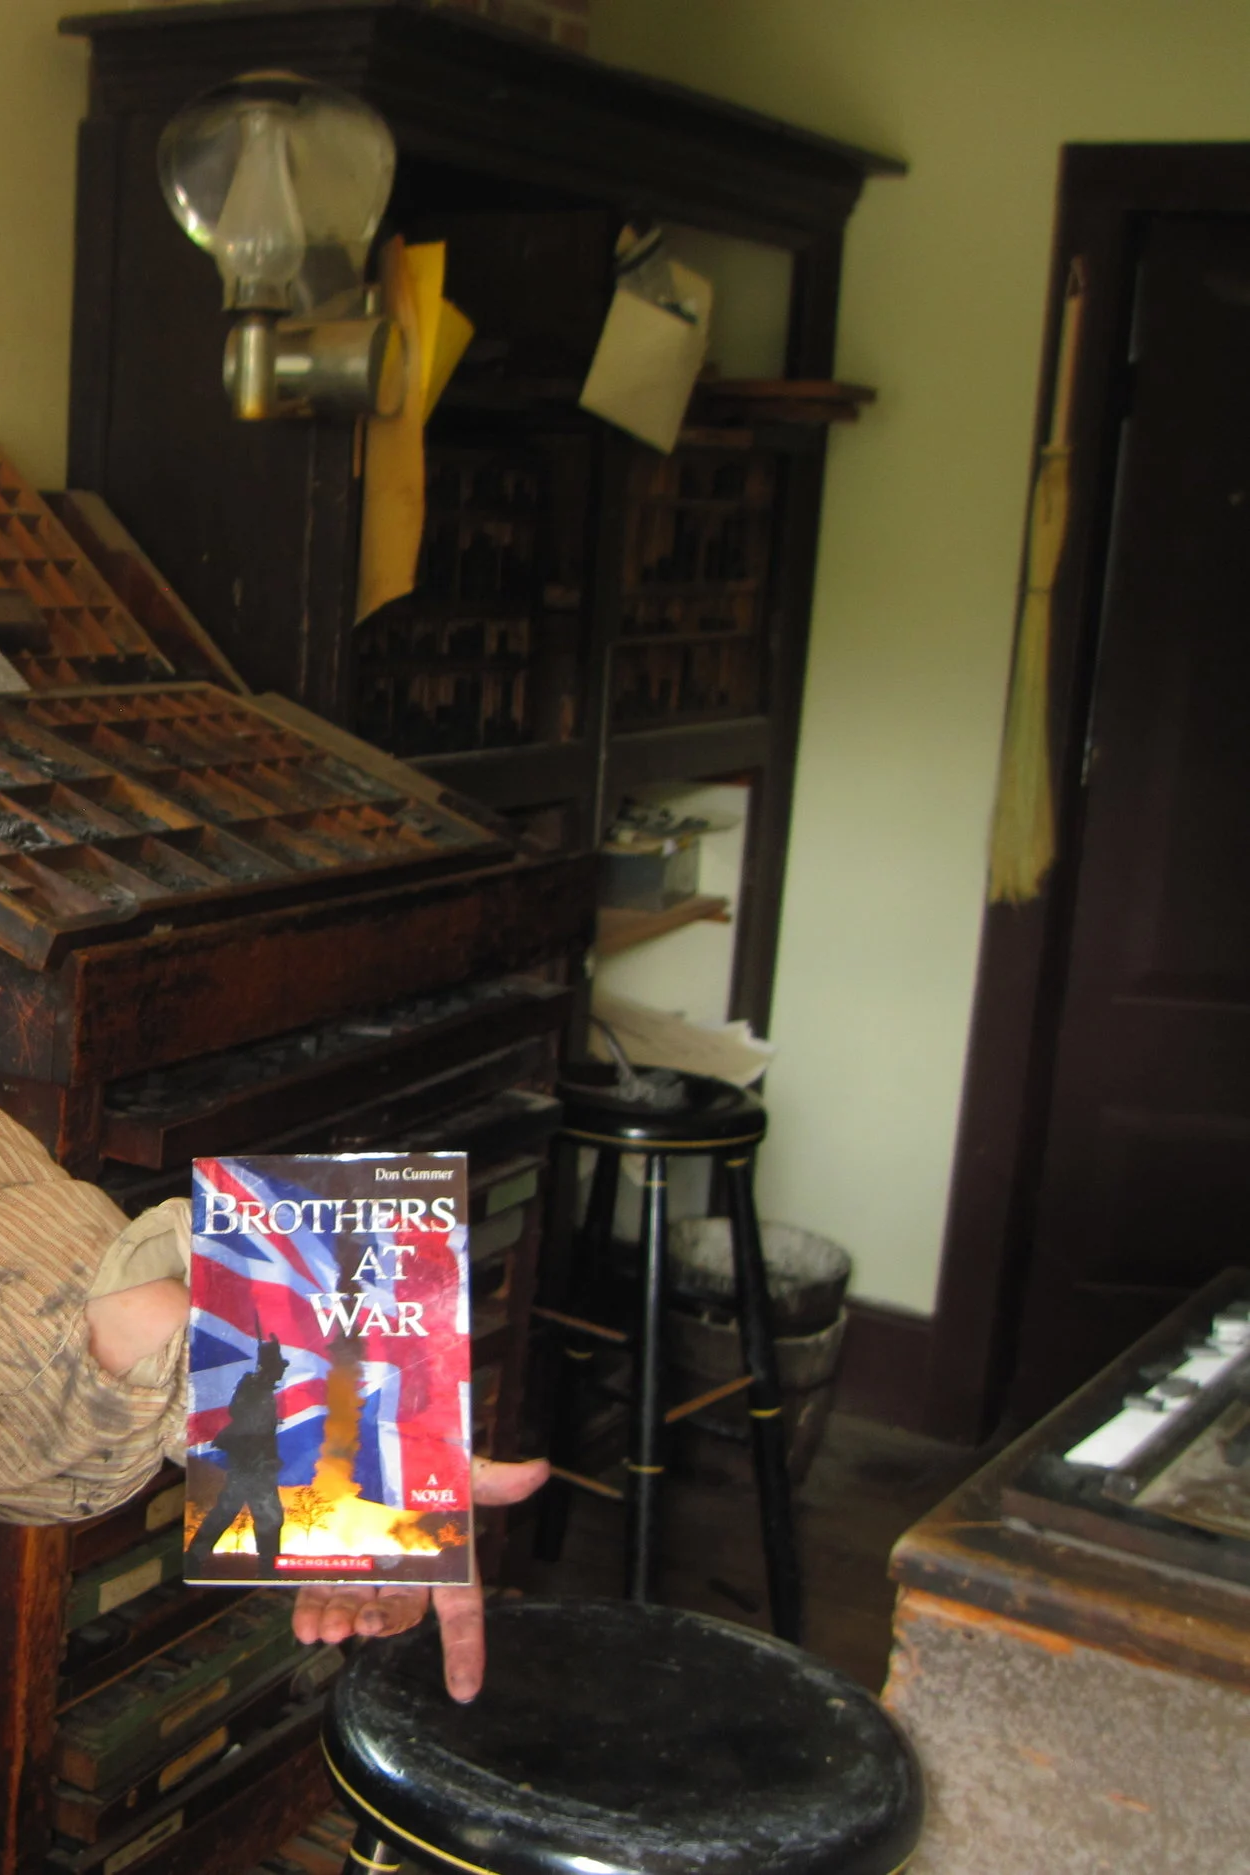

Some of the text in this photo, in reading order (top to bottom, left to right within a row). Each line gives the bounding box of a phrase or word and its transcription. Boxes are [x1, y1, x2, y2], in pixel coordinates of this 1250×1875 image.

[374, 1167, 454, 1181] Don Cummer
[199, 1192, 457, 1236] BROTHERS
[351, 1244, 415, 1281] AT
[305, 1292, 430, 1338] WAR
[426, 1473, 439, 1487] A
[410, 1489, 458, 1503] NOVEL
[289, 1558, 369, 1567] SCHOLASTIC
